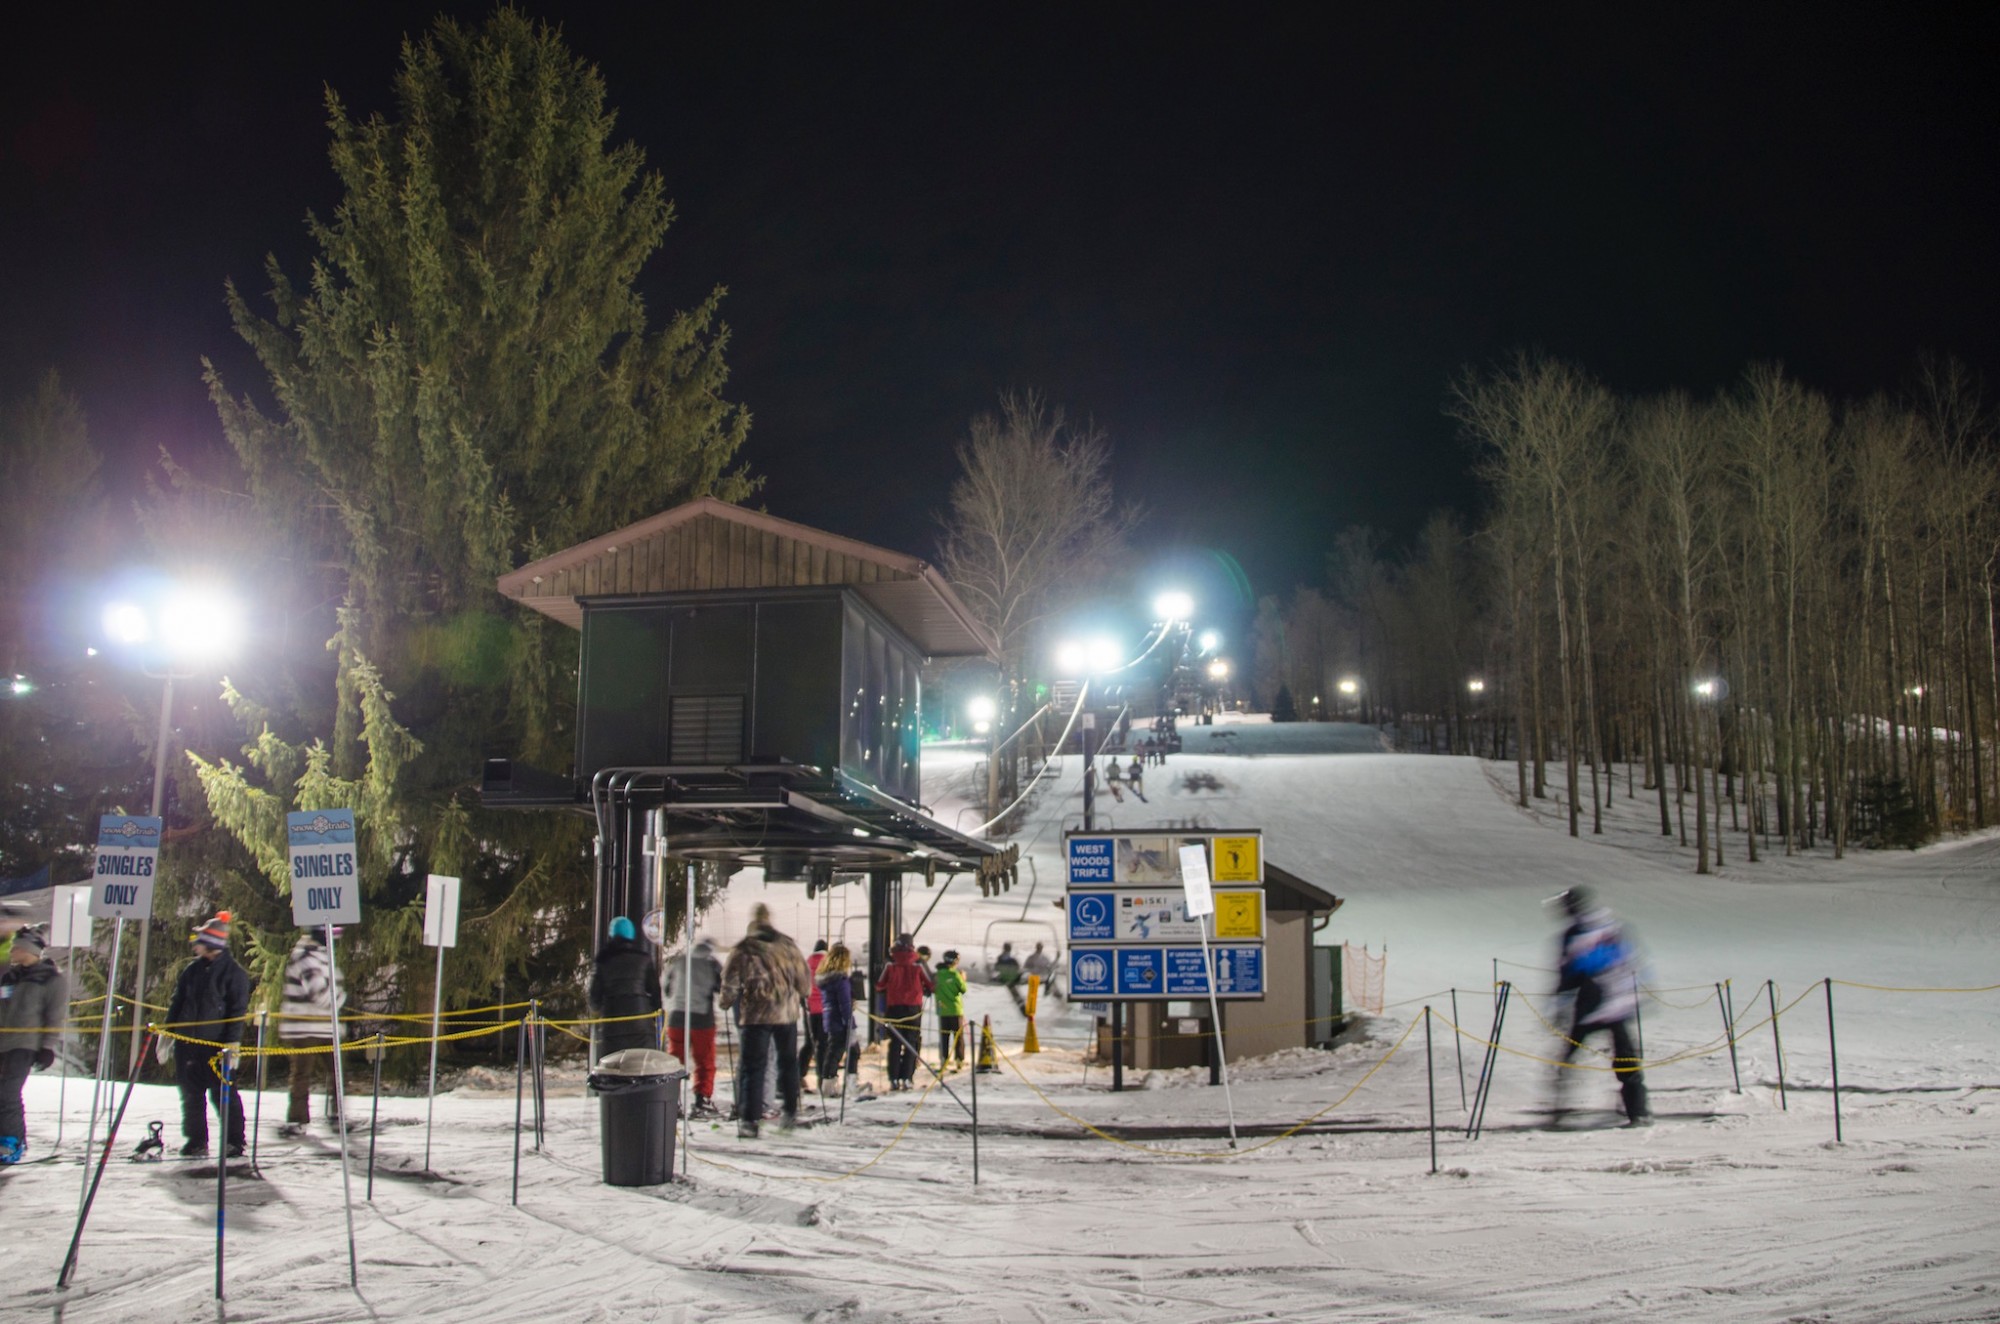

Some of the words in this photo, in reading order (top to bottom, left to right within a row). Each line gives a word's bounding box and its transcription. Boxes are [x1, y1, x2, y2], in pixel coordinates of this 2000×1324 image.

[328, 821, 351, 830] trails
[136, 827, 157, 836] trails
[1075, 844, 1105, 854] WEST
[97, 854, 153, 876] SINGLES
[294, 853, 353, 878] SINGLES
[1071, 856, 1110, 866] WOODS
[1072, 868, 1109, 878] TRIPLE
[104, 884, 139, 905] ONLY
[308, 886, 342, 910] ONLY
